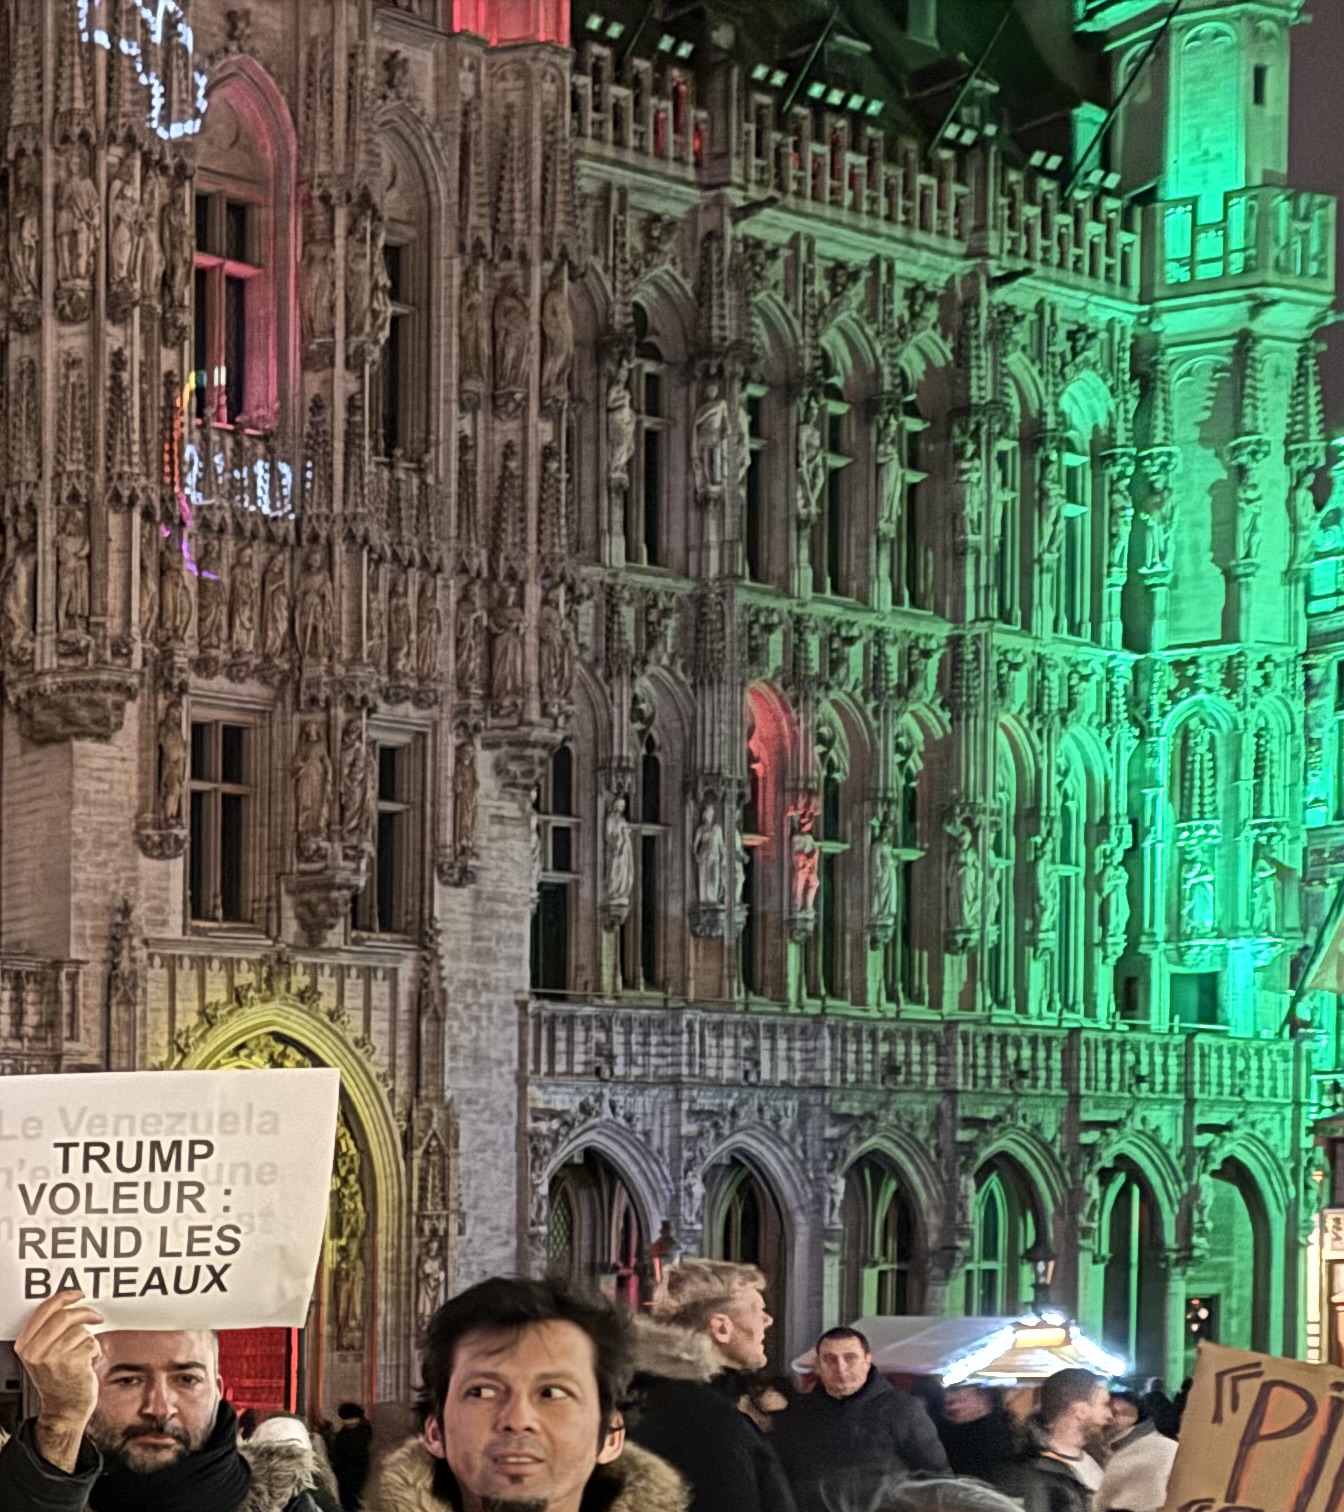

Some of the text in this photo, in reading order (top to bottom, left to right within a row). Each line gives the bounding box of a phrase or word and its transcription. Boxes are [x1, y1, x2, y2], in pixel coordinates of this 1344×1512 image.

[53, 1139, 216, 1175] TRUMP
[18, 1180, 207, 1217] VOLEUR
[18, 1225, 142, 1261] REND
[159, 1224, 242, 1258] LES
[24, 1263, 233, 1300] BATEAUX
